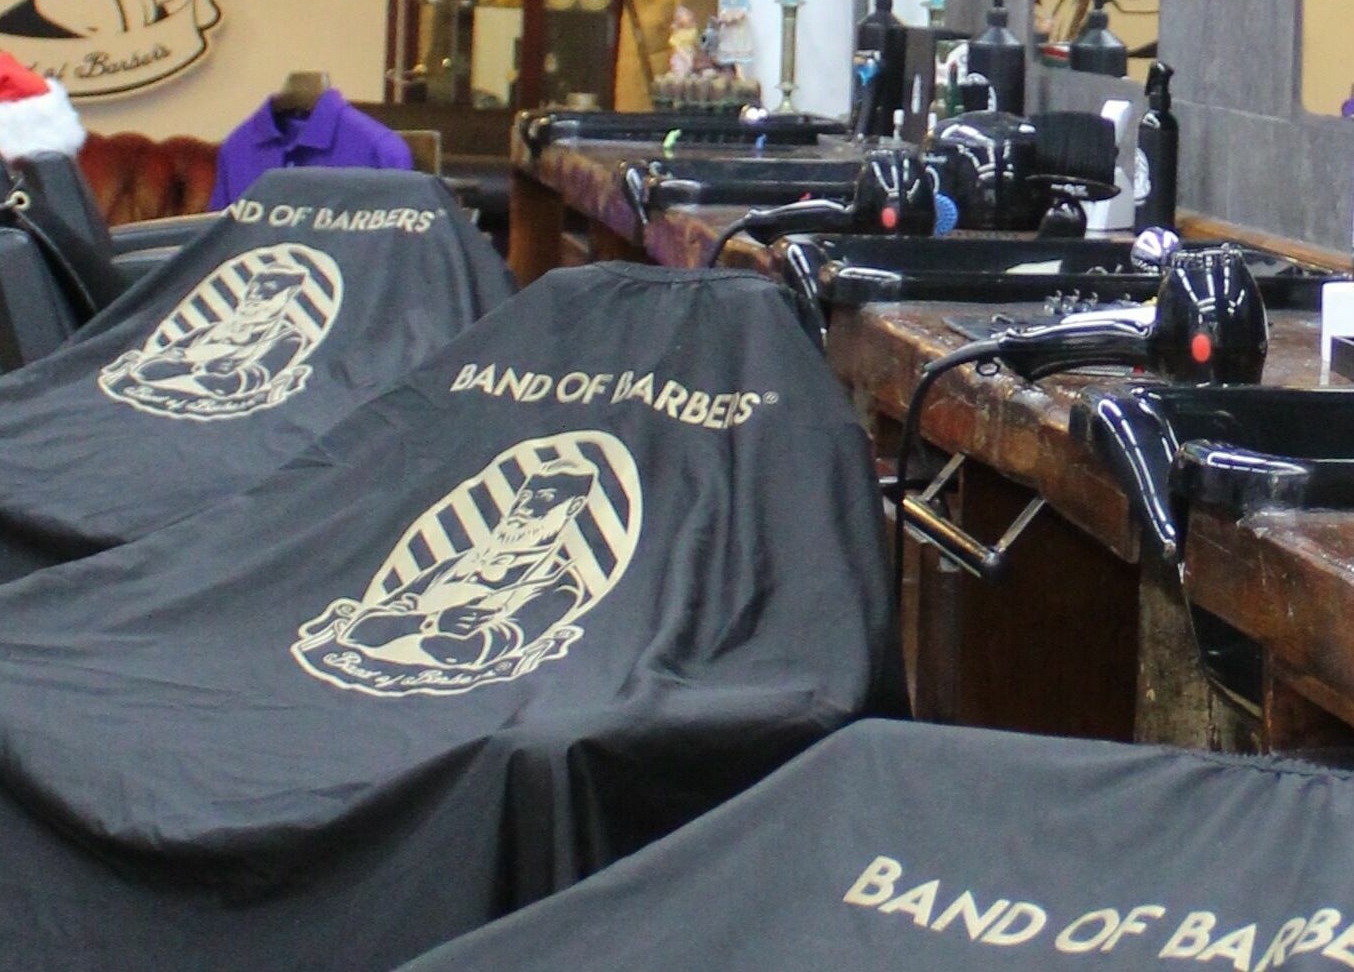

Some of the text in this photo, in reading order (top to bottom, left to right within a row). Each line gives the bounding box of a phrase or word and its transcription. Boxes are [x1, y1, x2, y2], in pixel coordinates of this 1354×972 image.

[268, 204, 312, 227] OF
[450, 364, 553, 402] BAND
[556, 372, 613, 404] OF
[843, 854, 1047, 951] BAND
[1054, 905, 1165, 953] OF
